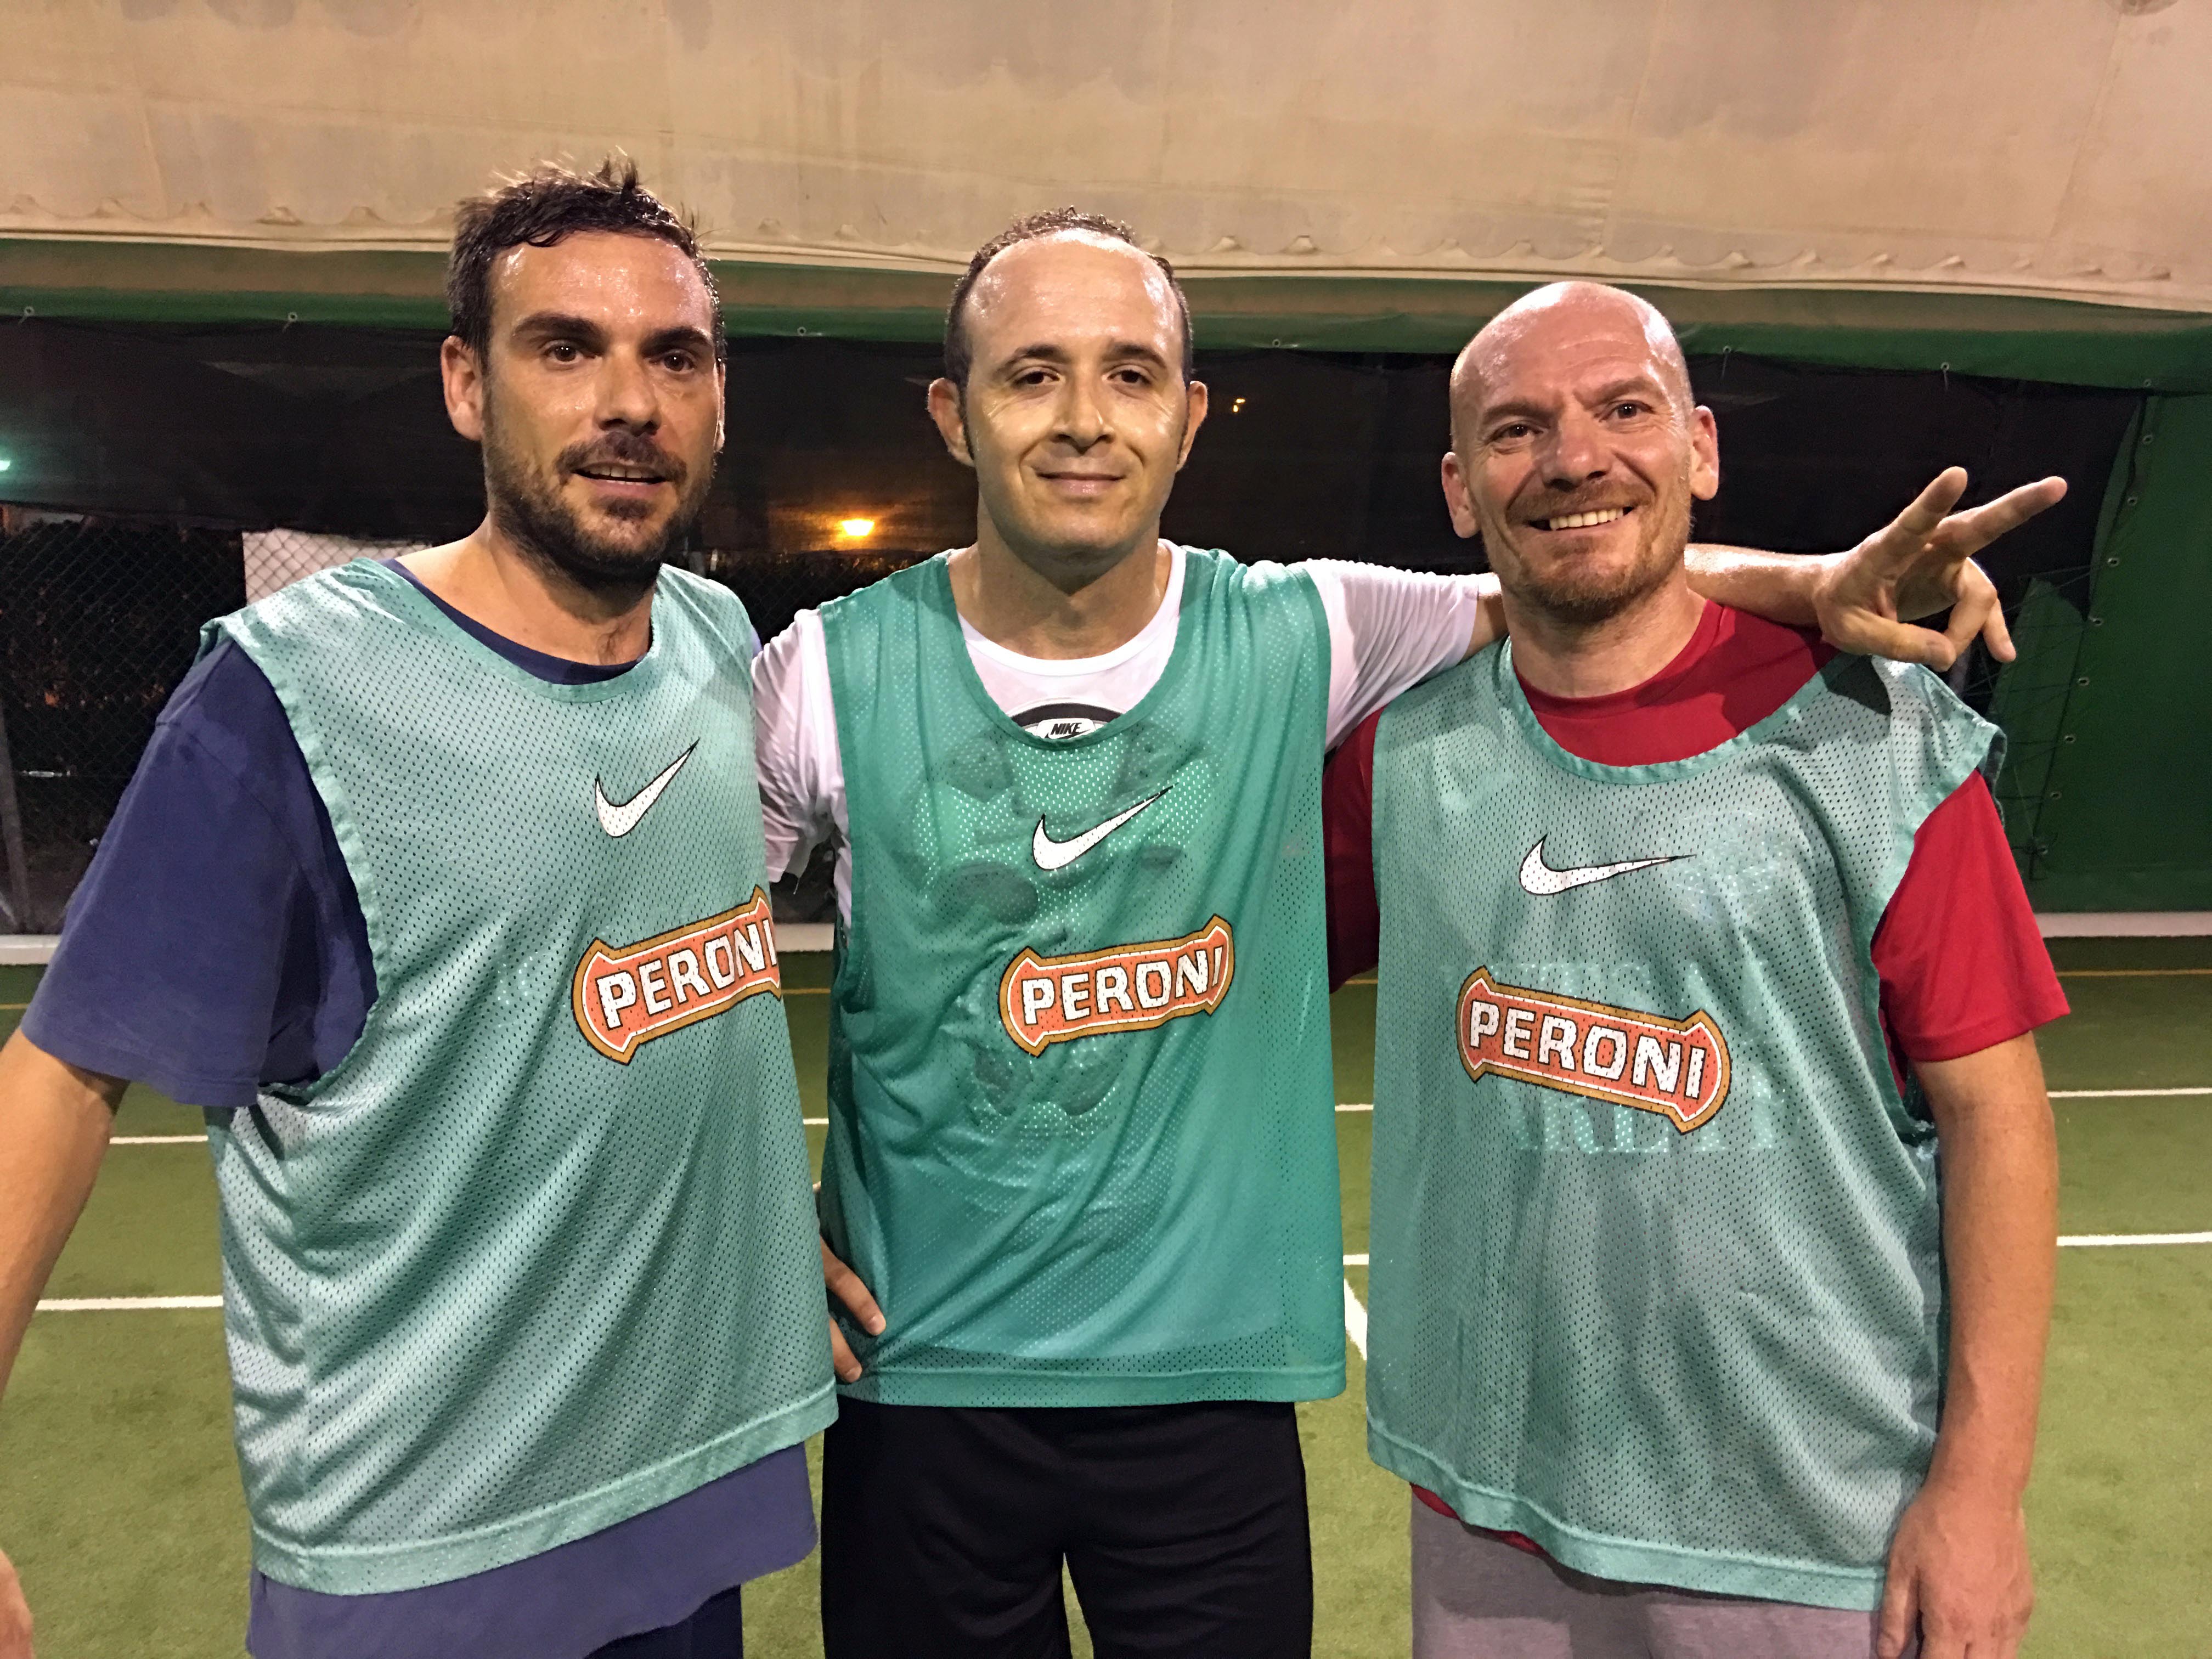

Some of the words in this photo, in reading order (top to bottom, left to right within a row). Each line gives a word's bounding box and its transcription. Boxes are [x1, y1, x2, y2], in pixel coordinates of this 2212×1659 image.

[1050, 723, 1082, 735] NIKE
[595, 919, 777, 1029] PERONI
[1021, 945, 1223, 1025] PERONI
[1469, 1000, 1706, 1099] PERONI
